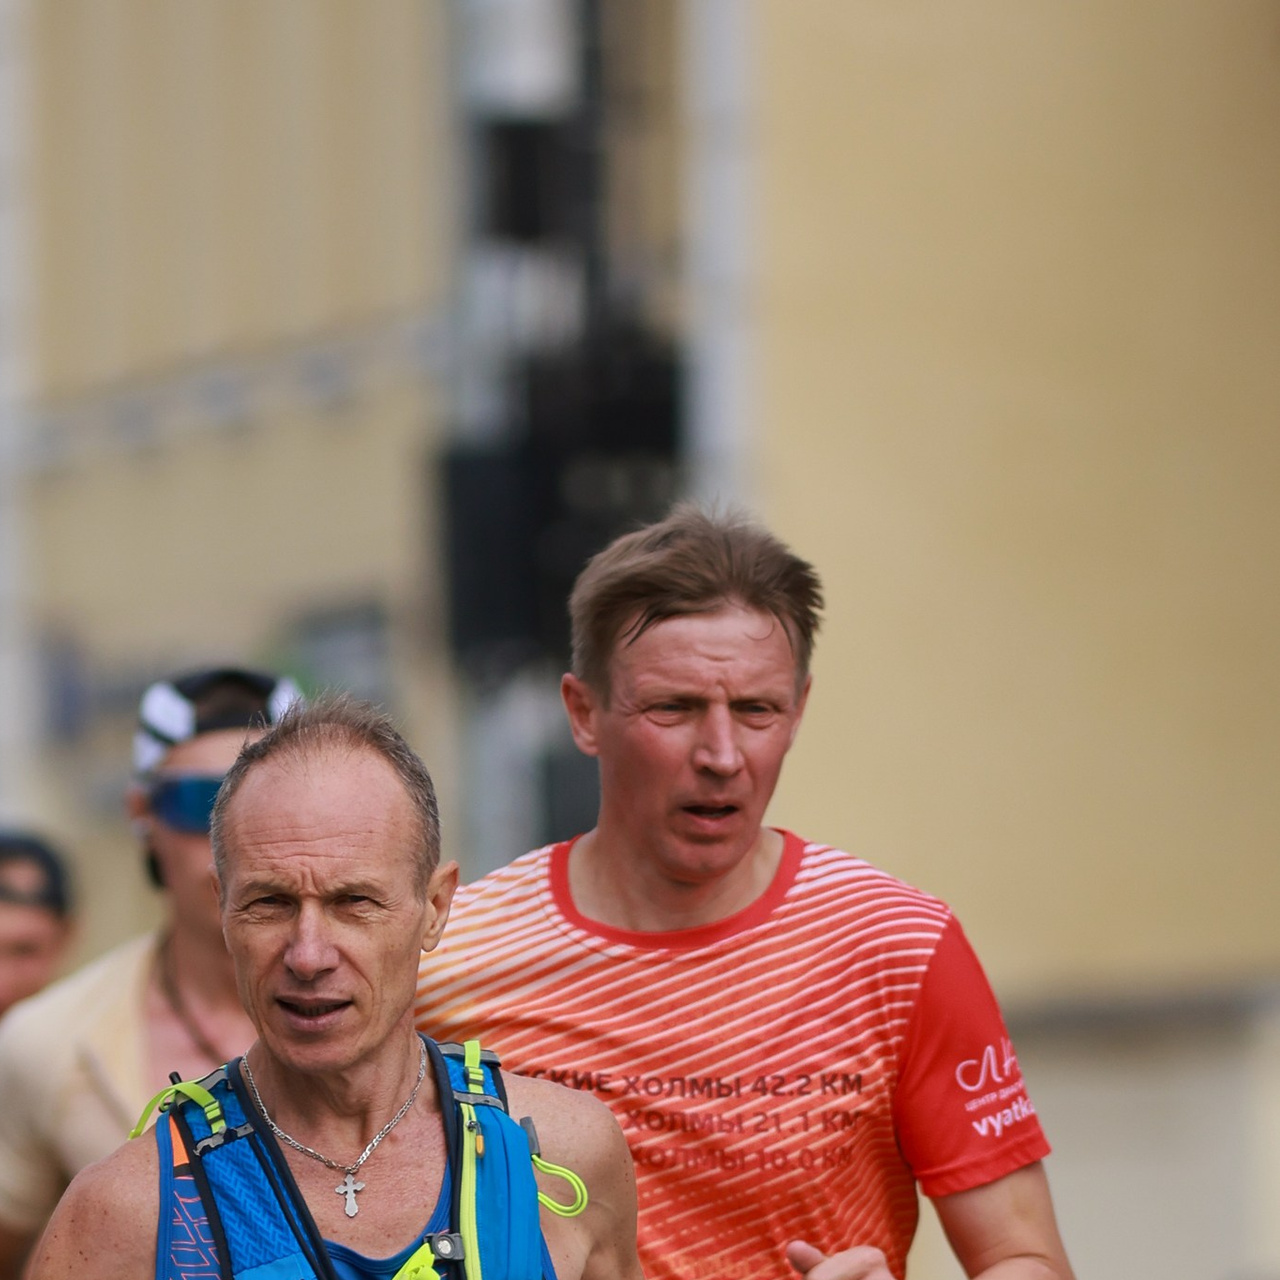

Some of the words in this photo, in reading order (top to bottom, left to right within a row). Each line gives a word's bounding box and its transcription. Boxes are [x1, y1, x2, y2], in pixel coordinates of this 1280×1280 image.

[622, 1074, 741, 1099] ХОЛМЫ
[750, 1073, 812, 1097] 42.2
[819, 1072, 863, 1096] КМ
[625, 1109, 744, 1134] ХОЛМЫ
[753, 1111, 810, 1133] 21.1
[822, 1110, 863, 1133] КМ
[759, 1149, 814, 1171] 10.0
[822, 1147, 854, 1169] КМ
